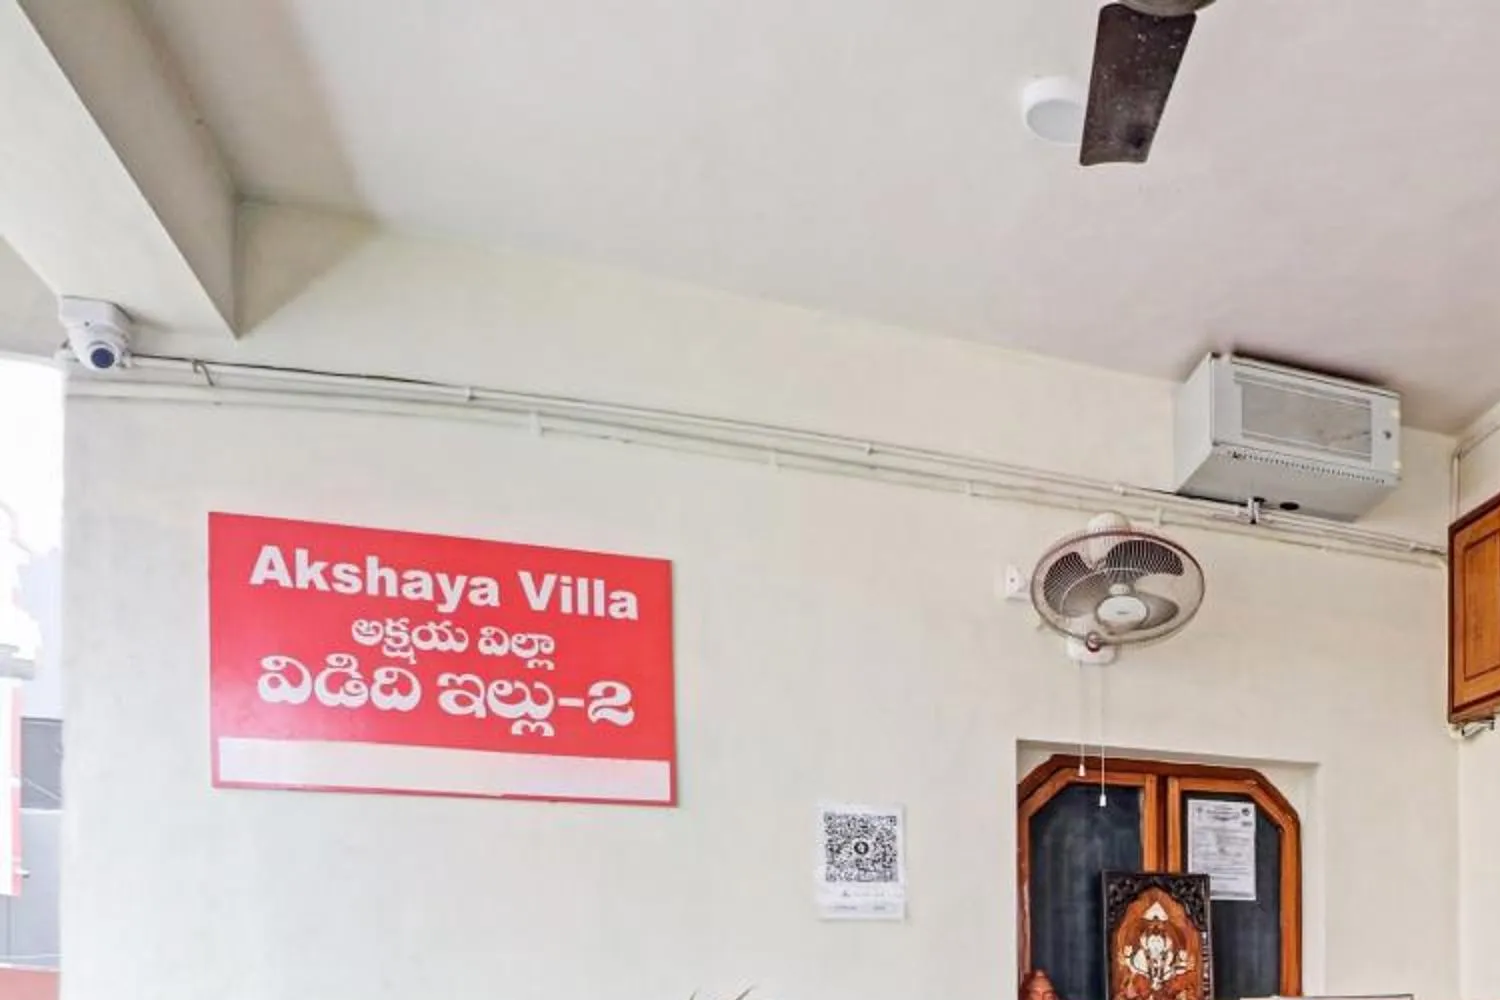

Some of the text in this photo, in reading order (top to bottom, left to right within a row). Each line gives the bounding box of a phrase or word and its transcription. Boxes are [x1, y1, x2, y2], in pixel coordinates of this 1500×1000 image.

[249, 544, 639, 620] Akshaya Villa
[351, 617, 555, 671] అక్షయ విల్లా
[257, 653, 422, 712] విడిది
